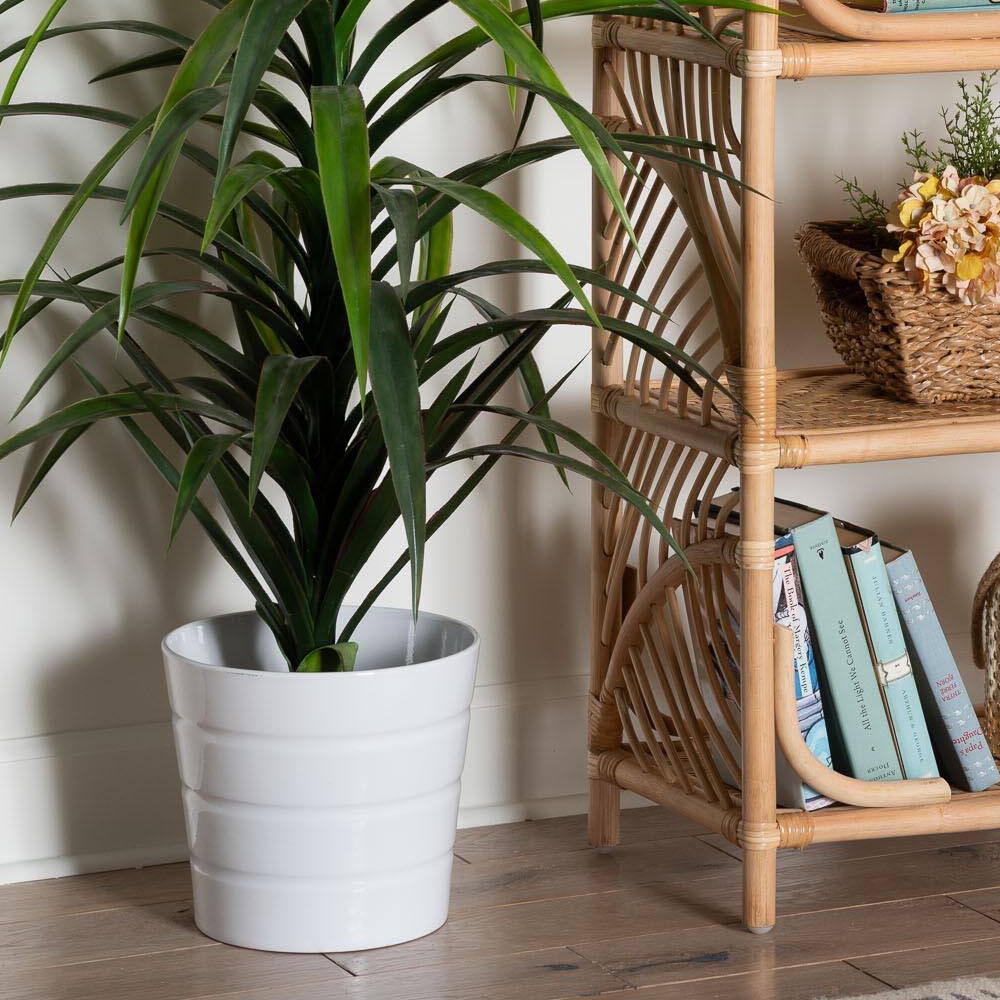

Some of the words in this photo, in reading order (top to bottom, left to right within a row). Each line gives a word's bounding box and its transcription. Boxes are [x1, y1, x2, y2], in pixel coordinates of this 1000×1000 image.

[784, 568, 793, 585] The
[787, 587, 798, 610] Book
[791, 613, 800, 622] of
[837, 620, 846, 635] See
[794, 625, 803, 659] Margery
[841, 635, 855, 666] Cannot
[800, 662, 808, 692] Kempe
[850, 667, 857, 680] We
[852, 681, 865, 703] Light
[859, 704, 869, 717] the
[862, 719, 872, 731] All
[952, 727, 984, 744] Daughte
[960, 741, 984, 756] Papa's
